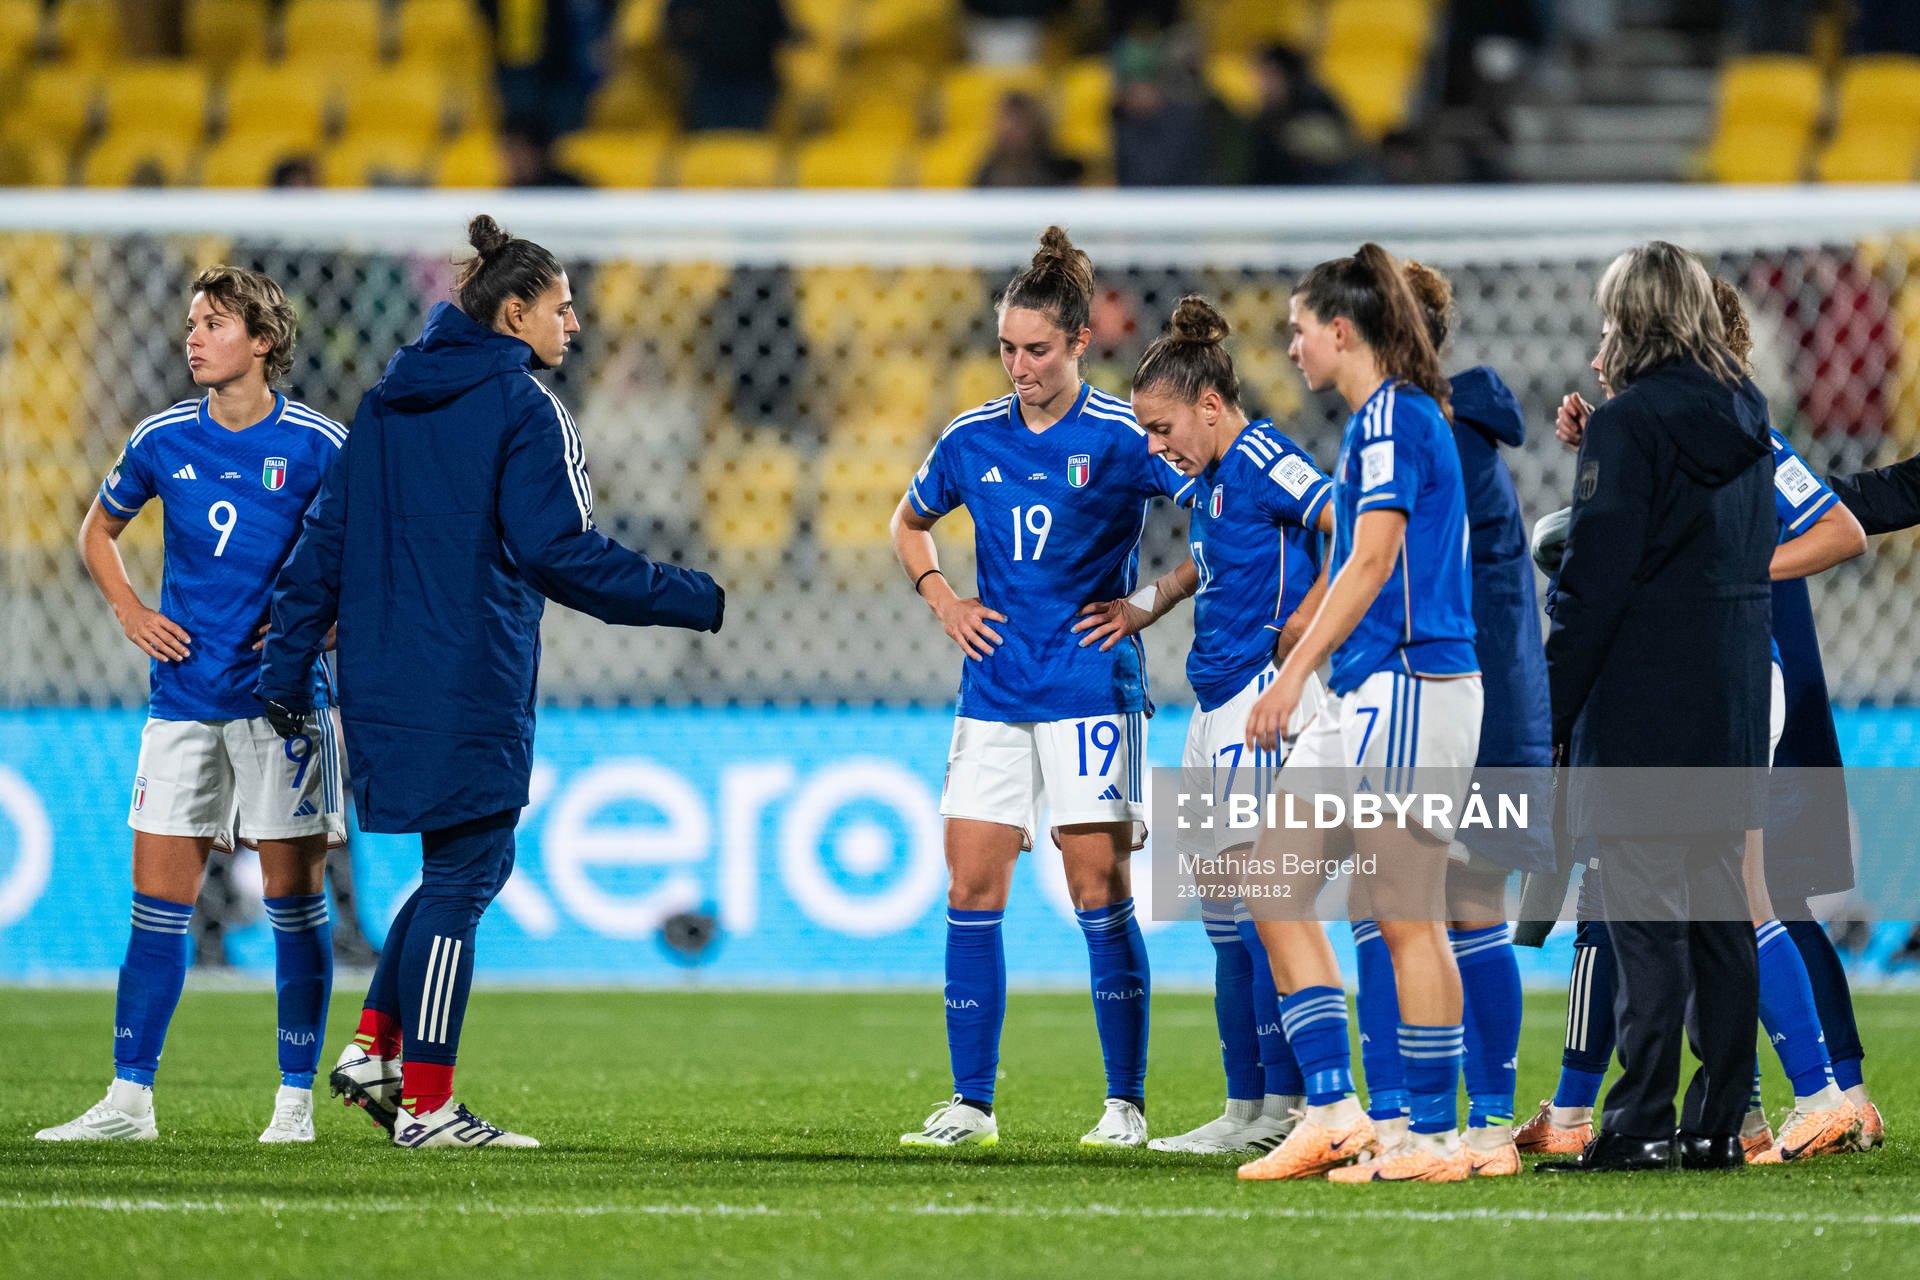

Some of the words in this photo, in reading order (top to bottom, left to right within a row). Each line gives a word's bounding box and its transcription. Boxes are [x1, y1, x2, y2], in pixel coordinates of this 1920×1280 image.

[266, 459, 285, 467] ITALIA
[1070, 456, 1088, 465] ITALIA
[208, 500, 237, 557] 9
[1010, 504, 1053, 561] 19
[1075, 720, 1121, 777] 19
[1356, 707, 1380, 766] 7
[284, 733, 313, 789] 9
[945, 999, 980, 1009] ALIA
[1095, 987, 1144, 1001] ITALIA
[114, 1027, 133, 1039] LIA
